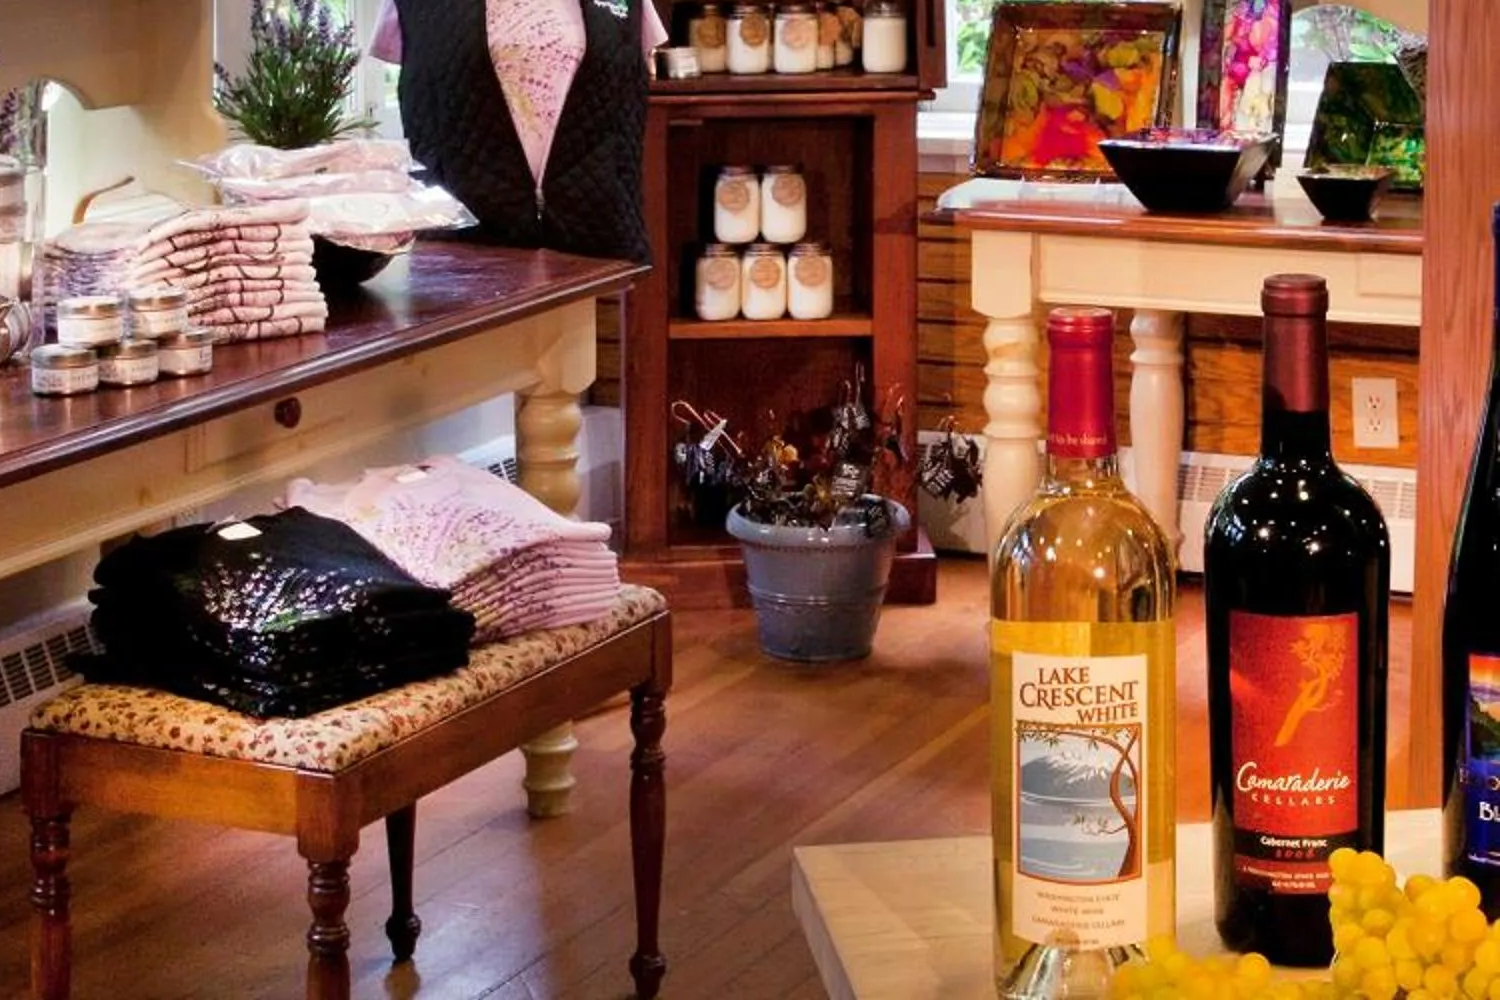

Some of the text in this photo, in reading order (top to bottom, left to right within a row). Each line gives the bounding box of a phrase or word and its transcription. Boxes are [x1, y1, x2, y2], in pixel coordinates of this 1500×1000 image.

[1038, 667, 1090, 685] LAKE
[1019, 681, 1139, 710] CRESCENT
[1077, 702, 1138, 722] WHITE
[1237, 761, 1350, 792] Camaraderie
[1251, 793, 1336, 807] CELLARS
